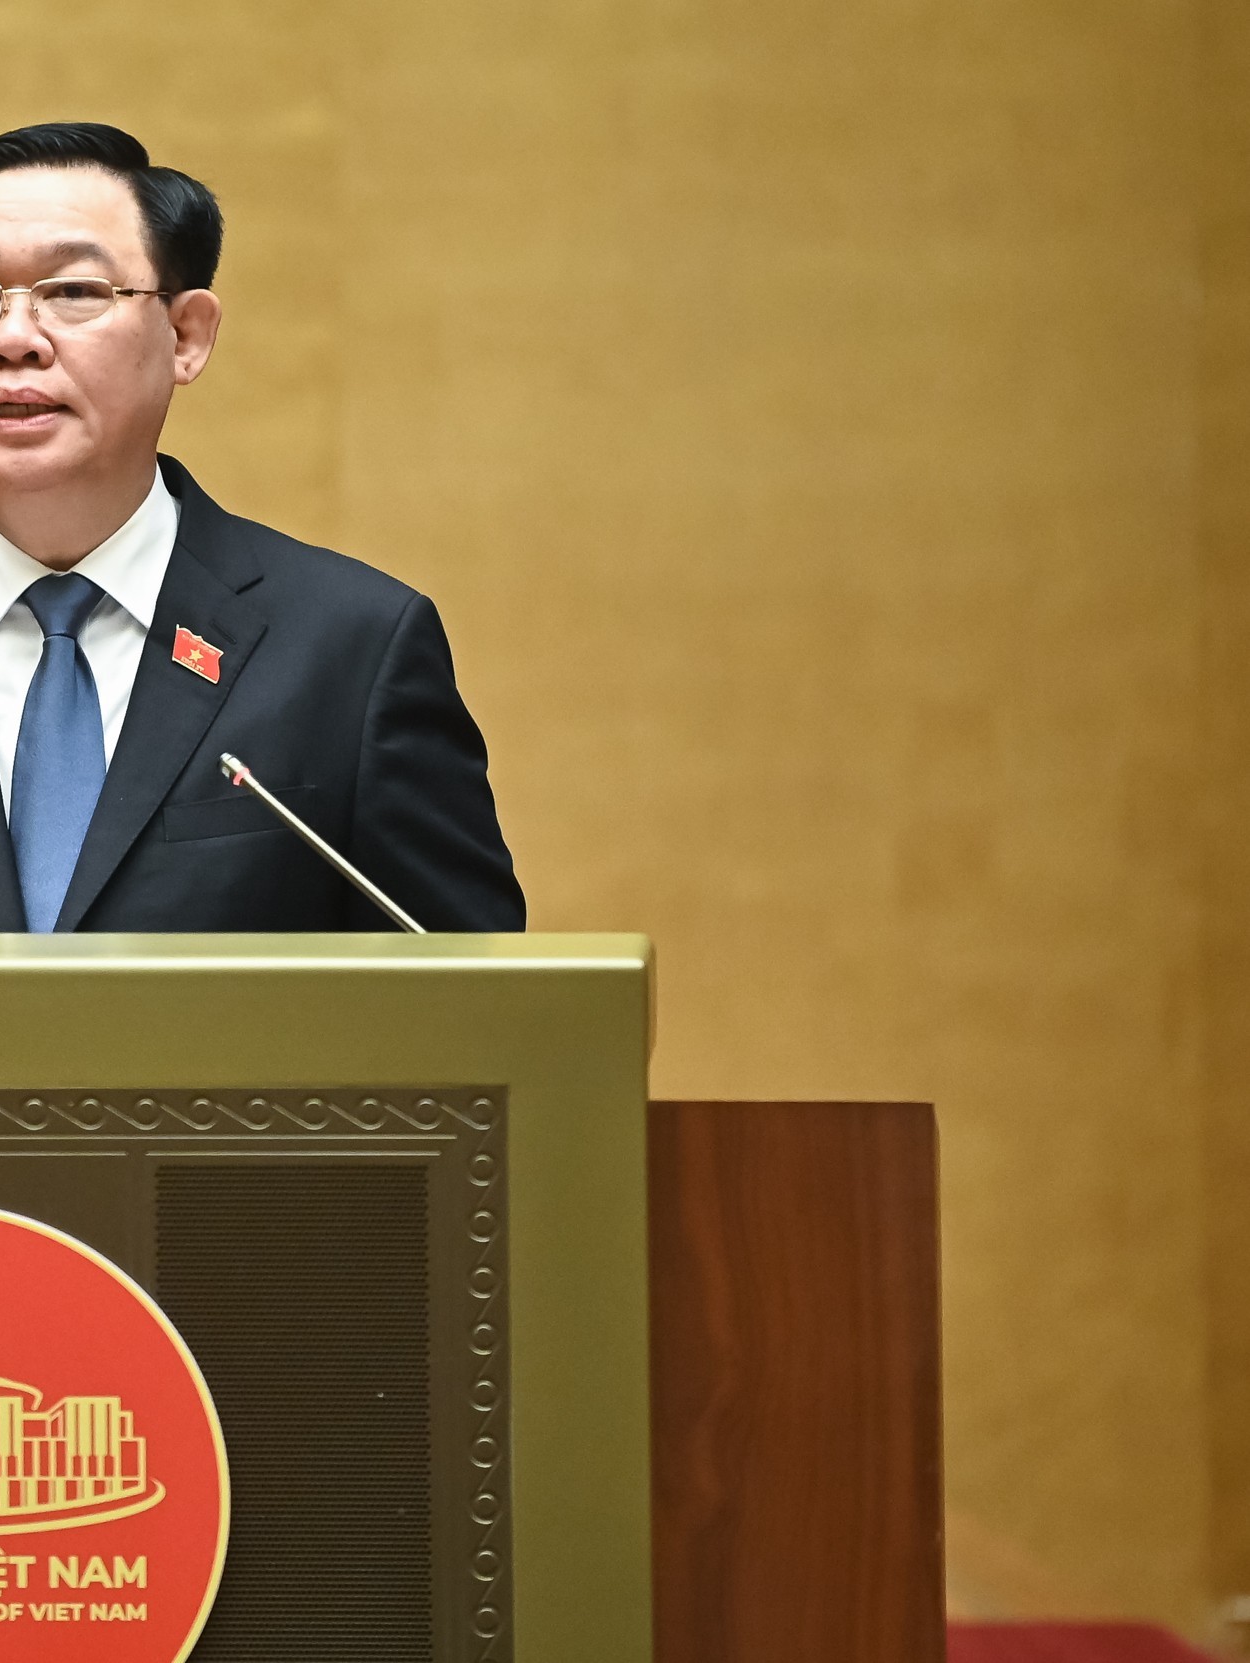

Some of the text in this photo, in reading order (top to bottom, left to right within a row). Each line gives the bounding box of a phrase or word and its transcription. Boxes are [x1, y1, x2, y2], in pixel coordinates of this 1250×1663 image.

[49, 1556, 147, 1589] NAM
[29, 1603, 85, 1621] VIET
[90, 1603, 147, 1621] NAM
